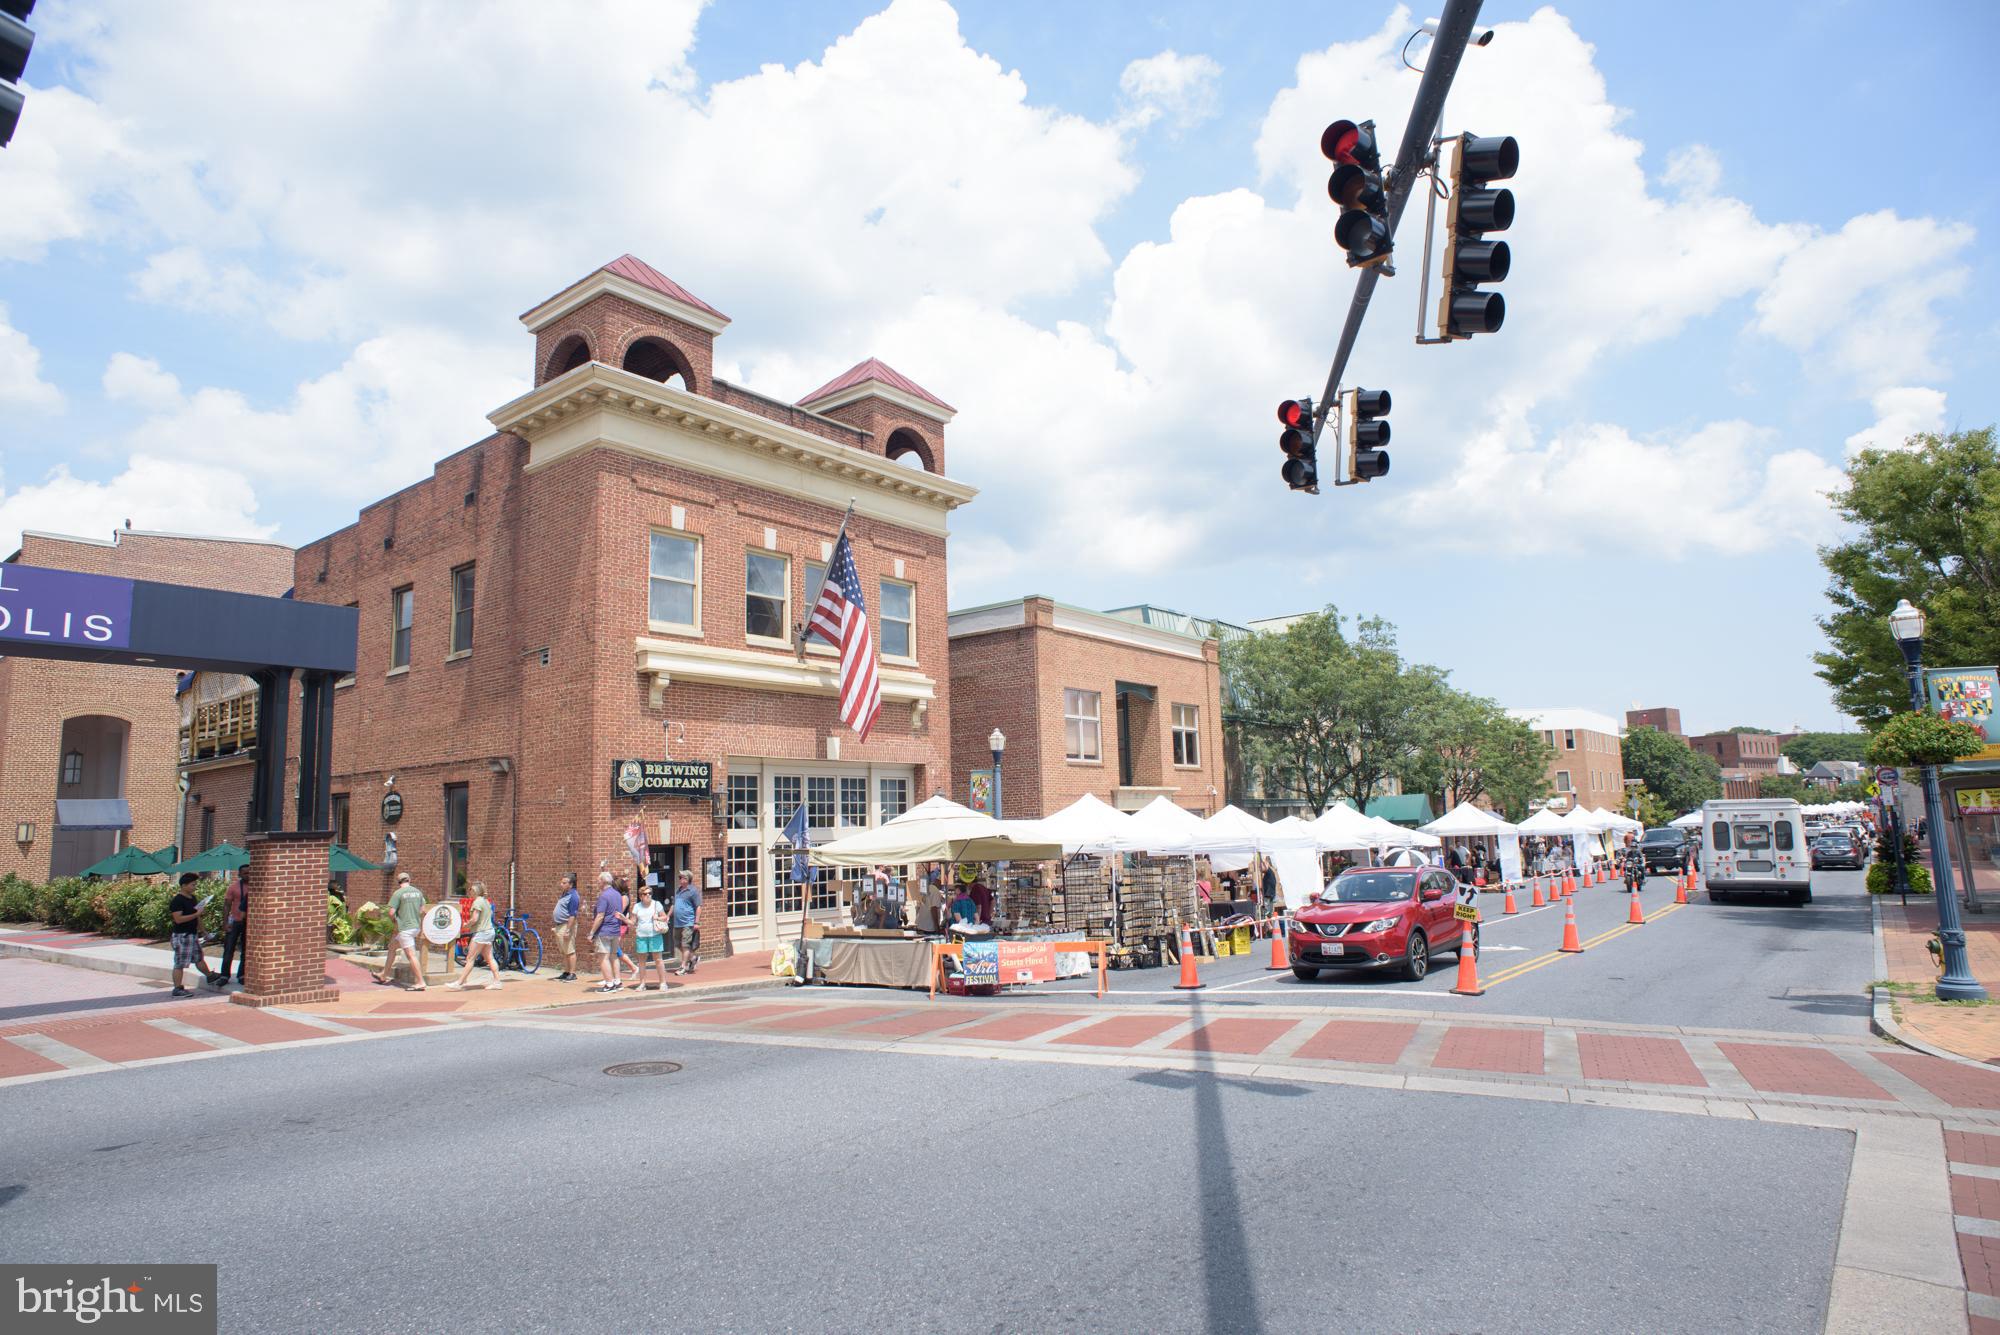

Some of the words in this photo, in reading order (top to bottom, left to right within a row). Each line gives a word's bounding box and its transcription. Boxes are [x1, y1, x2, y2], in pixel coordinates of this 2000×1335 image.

[1937, 681, 1992, 701] CRAB
[645, 764, 708, 776] BREWING
[644, 777, 709, 788] COMPANY
[1458, 905, 1475, 913] KEEP
[1455, 911, 1476, 920] RIGHT
[1002, 946, 1016, 954] The
[1017, 943, 1046, 953] Festival
[964, 959, 998, 976] Arts
[1001, 958, 1024, 967] Starts
[965, 974, 998, 986] FESTIVAL
